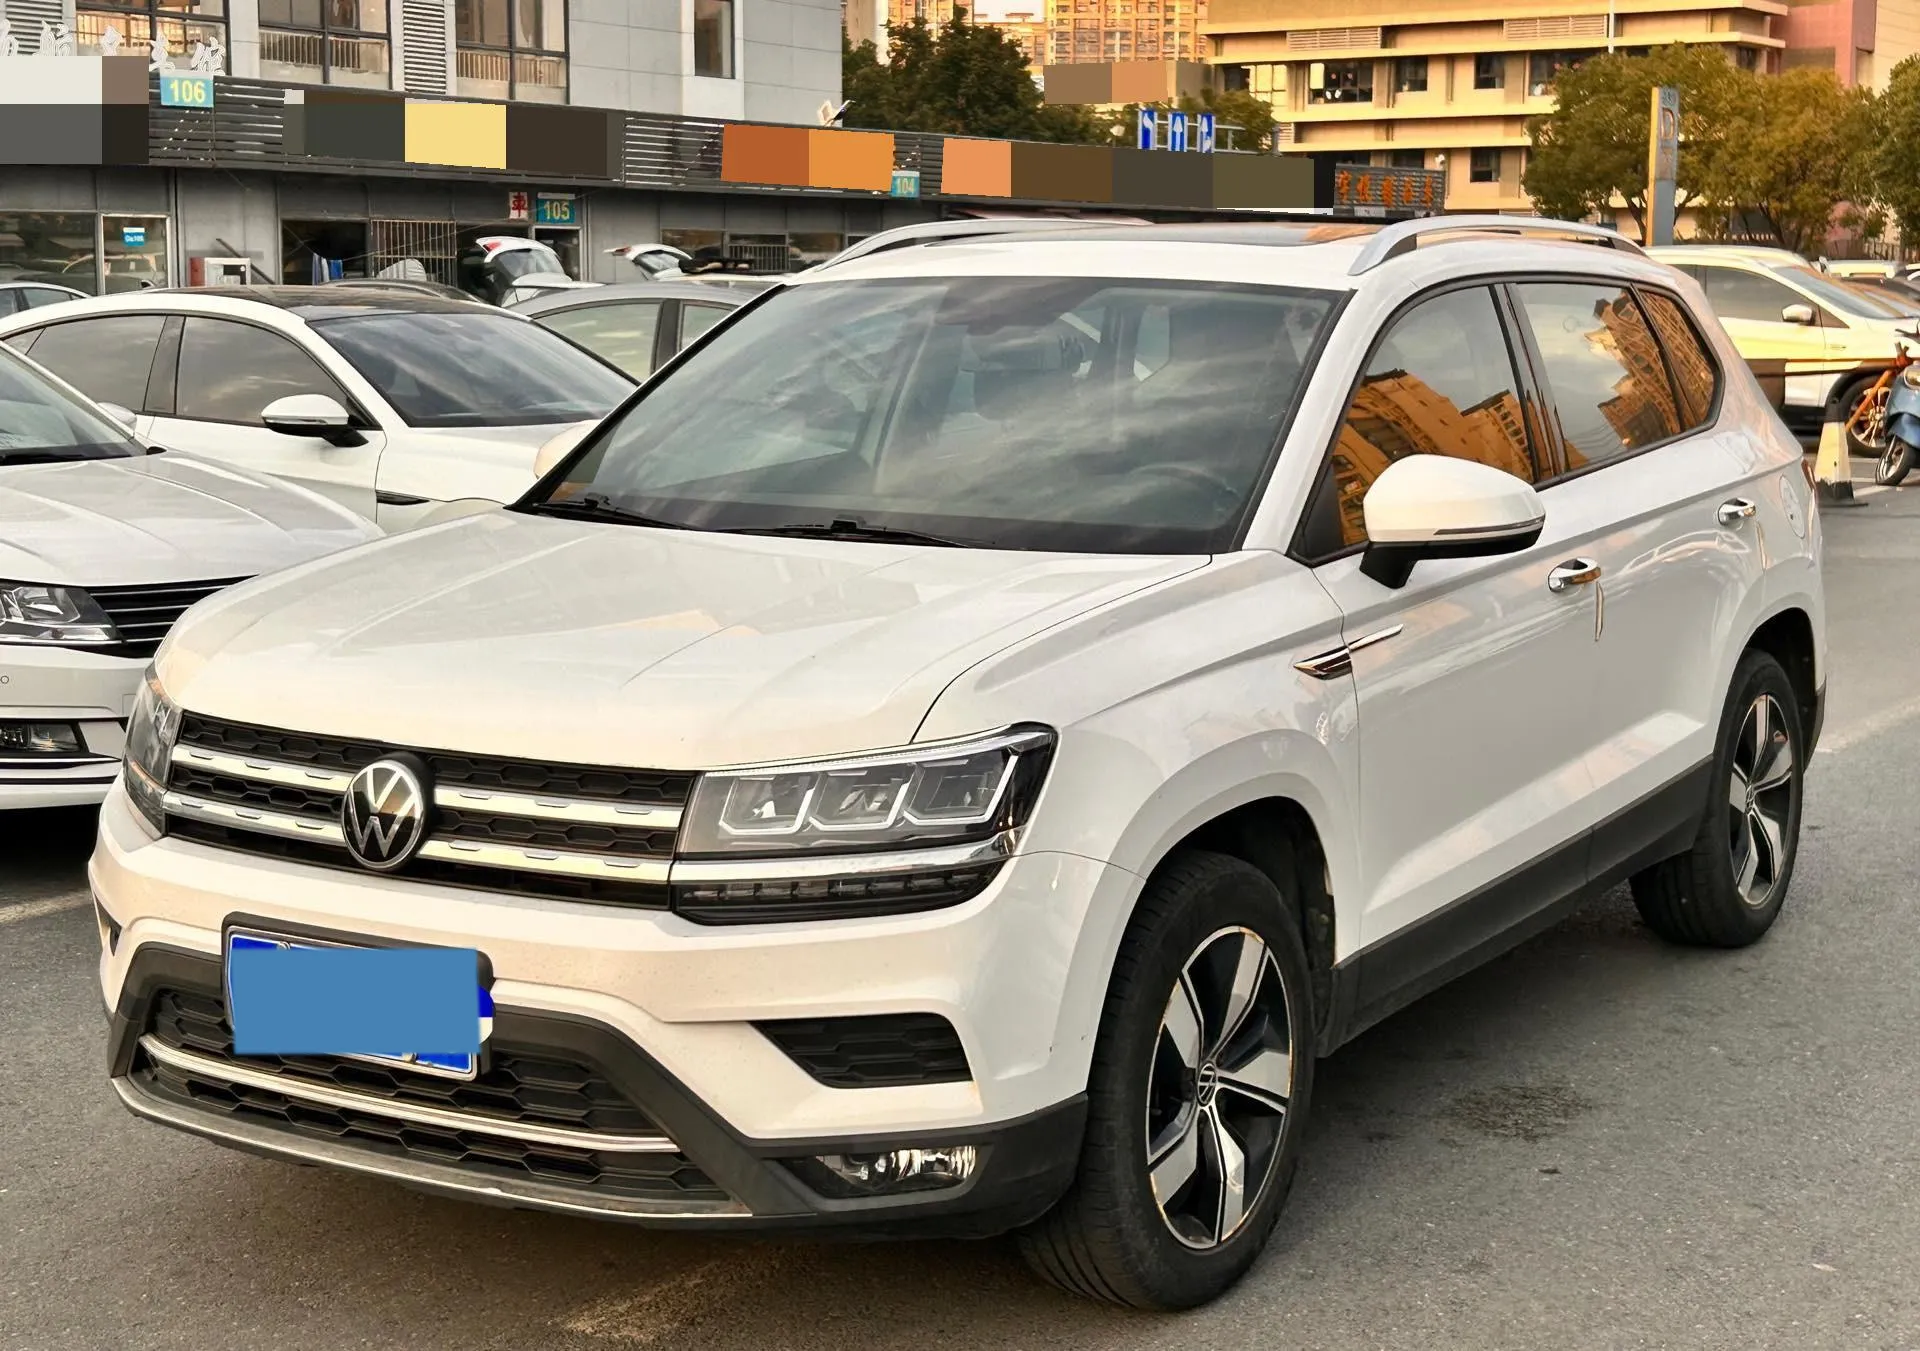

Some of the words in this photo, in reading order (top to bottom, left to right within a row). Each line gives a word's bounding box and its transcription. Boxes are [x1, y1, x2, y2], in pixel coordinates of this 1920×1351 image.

[170, 80, 206, 103] 106
[1661, 107, 1675, 140] D
[897, 178, 915, 194] 104
[544, 201, 570, 220] 105
[346, 764, 418, 860] VW
